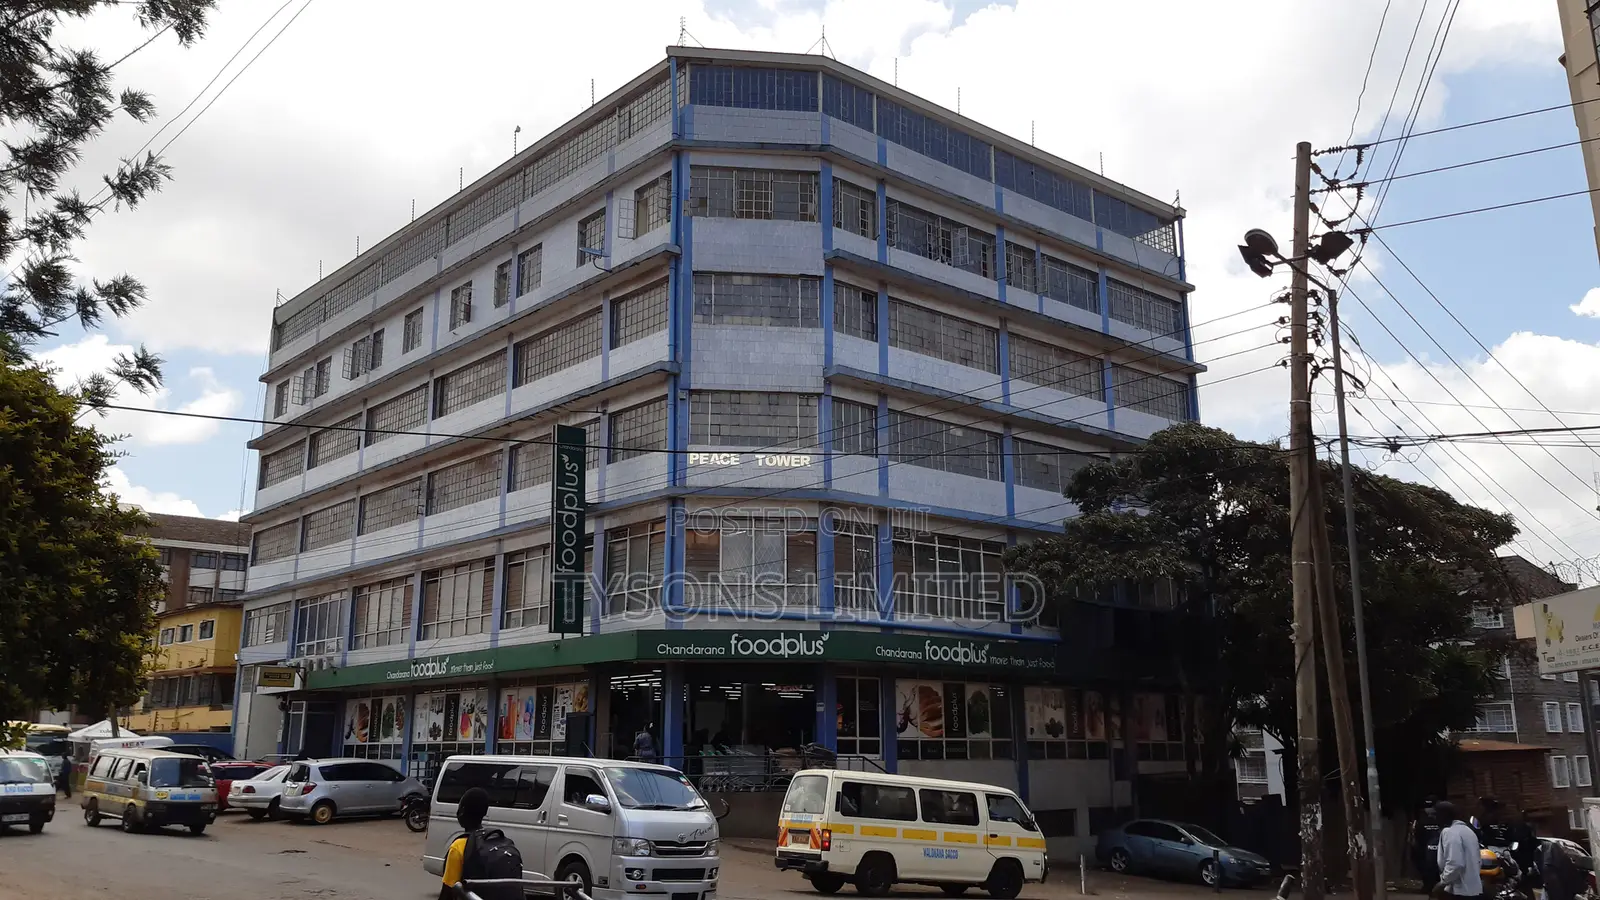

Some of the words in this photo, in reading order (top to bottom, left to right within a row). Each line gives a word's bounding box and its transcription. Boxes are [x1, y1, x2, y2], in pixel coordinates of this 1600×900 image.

[688, 452, 740, 466] PEACE
[755, 454, 811, 467] TOWER
[556, 461, 585, 574] foodplus
[656, 643, 725, 656] Chandarana
[730, 632, 824, 658] foodplus
[875, 645, 922, 660] Chandarana
[924, 640, 988, 665] foodplus
[410, 657, 447, 678] foodplus
